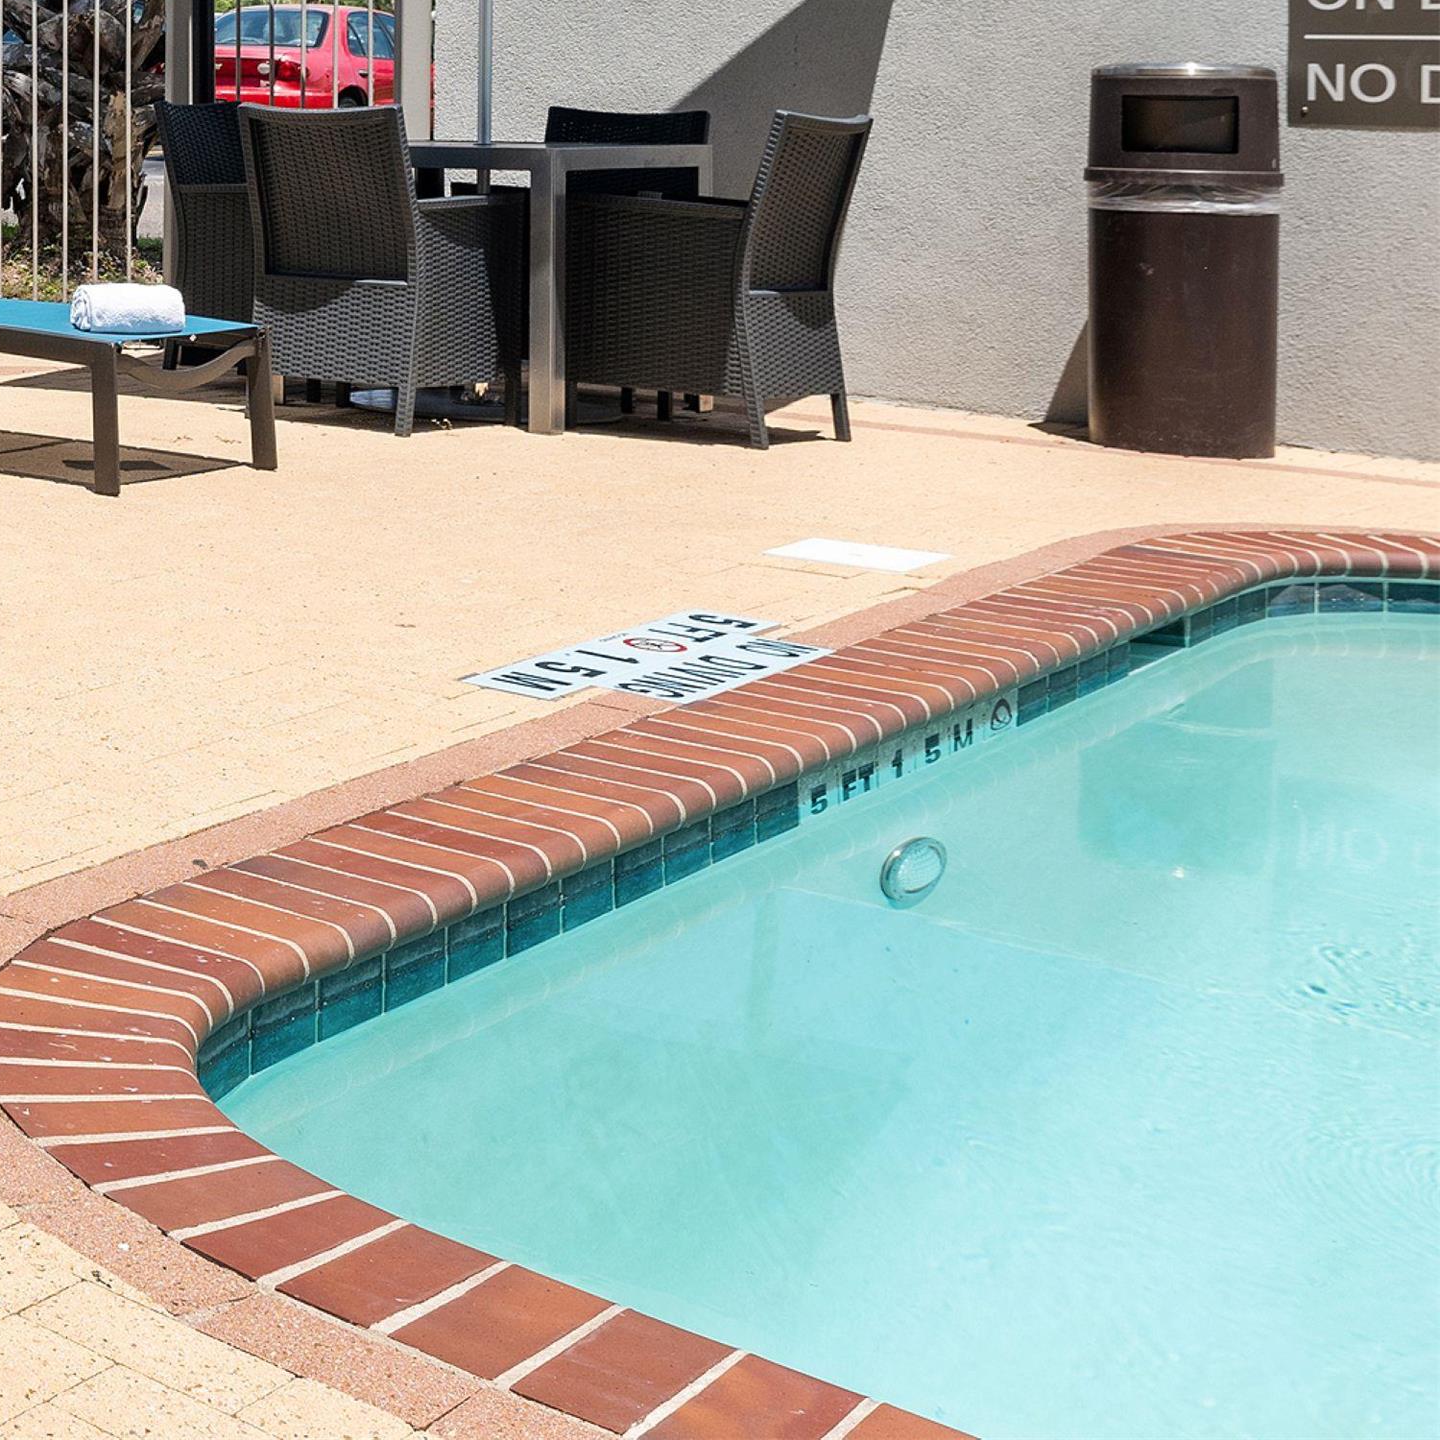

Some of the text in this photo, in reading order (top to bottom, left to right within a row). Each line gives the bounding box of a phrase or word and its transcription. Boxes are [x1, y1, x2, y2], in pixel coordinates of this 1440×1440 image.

[1307, 63, 1397, 103] NO
[619, 637, 819, 698] NO DIVING
[842, 761, 875, 801] FT
[953, 718, 973, 753] M
